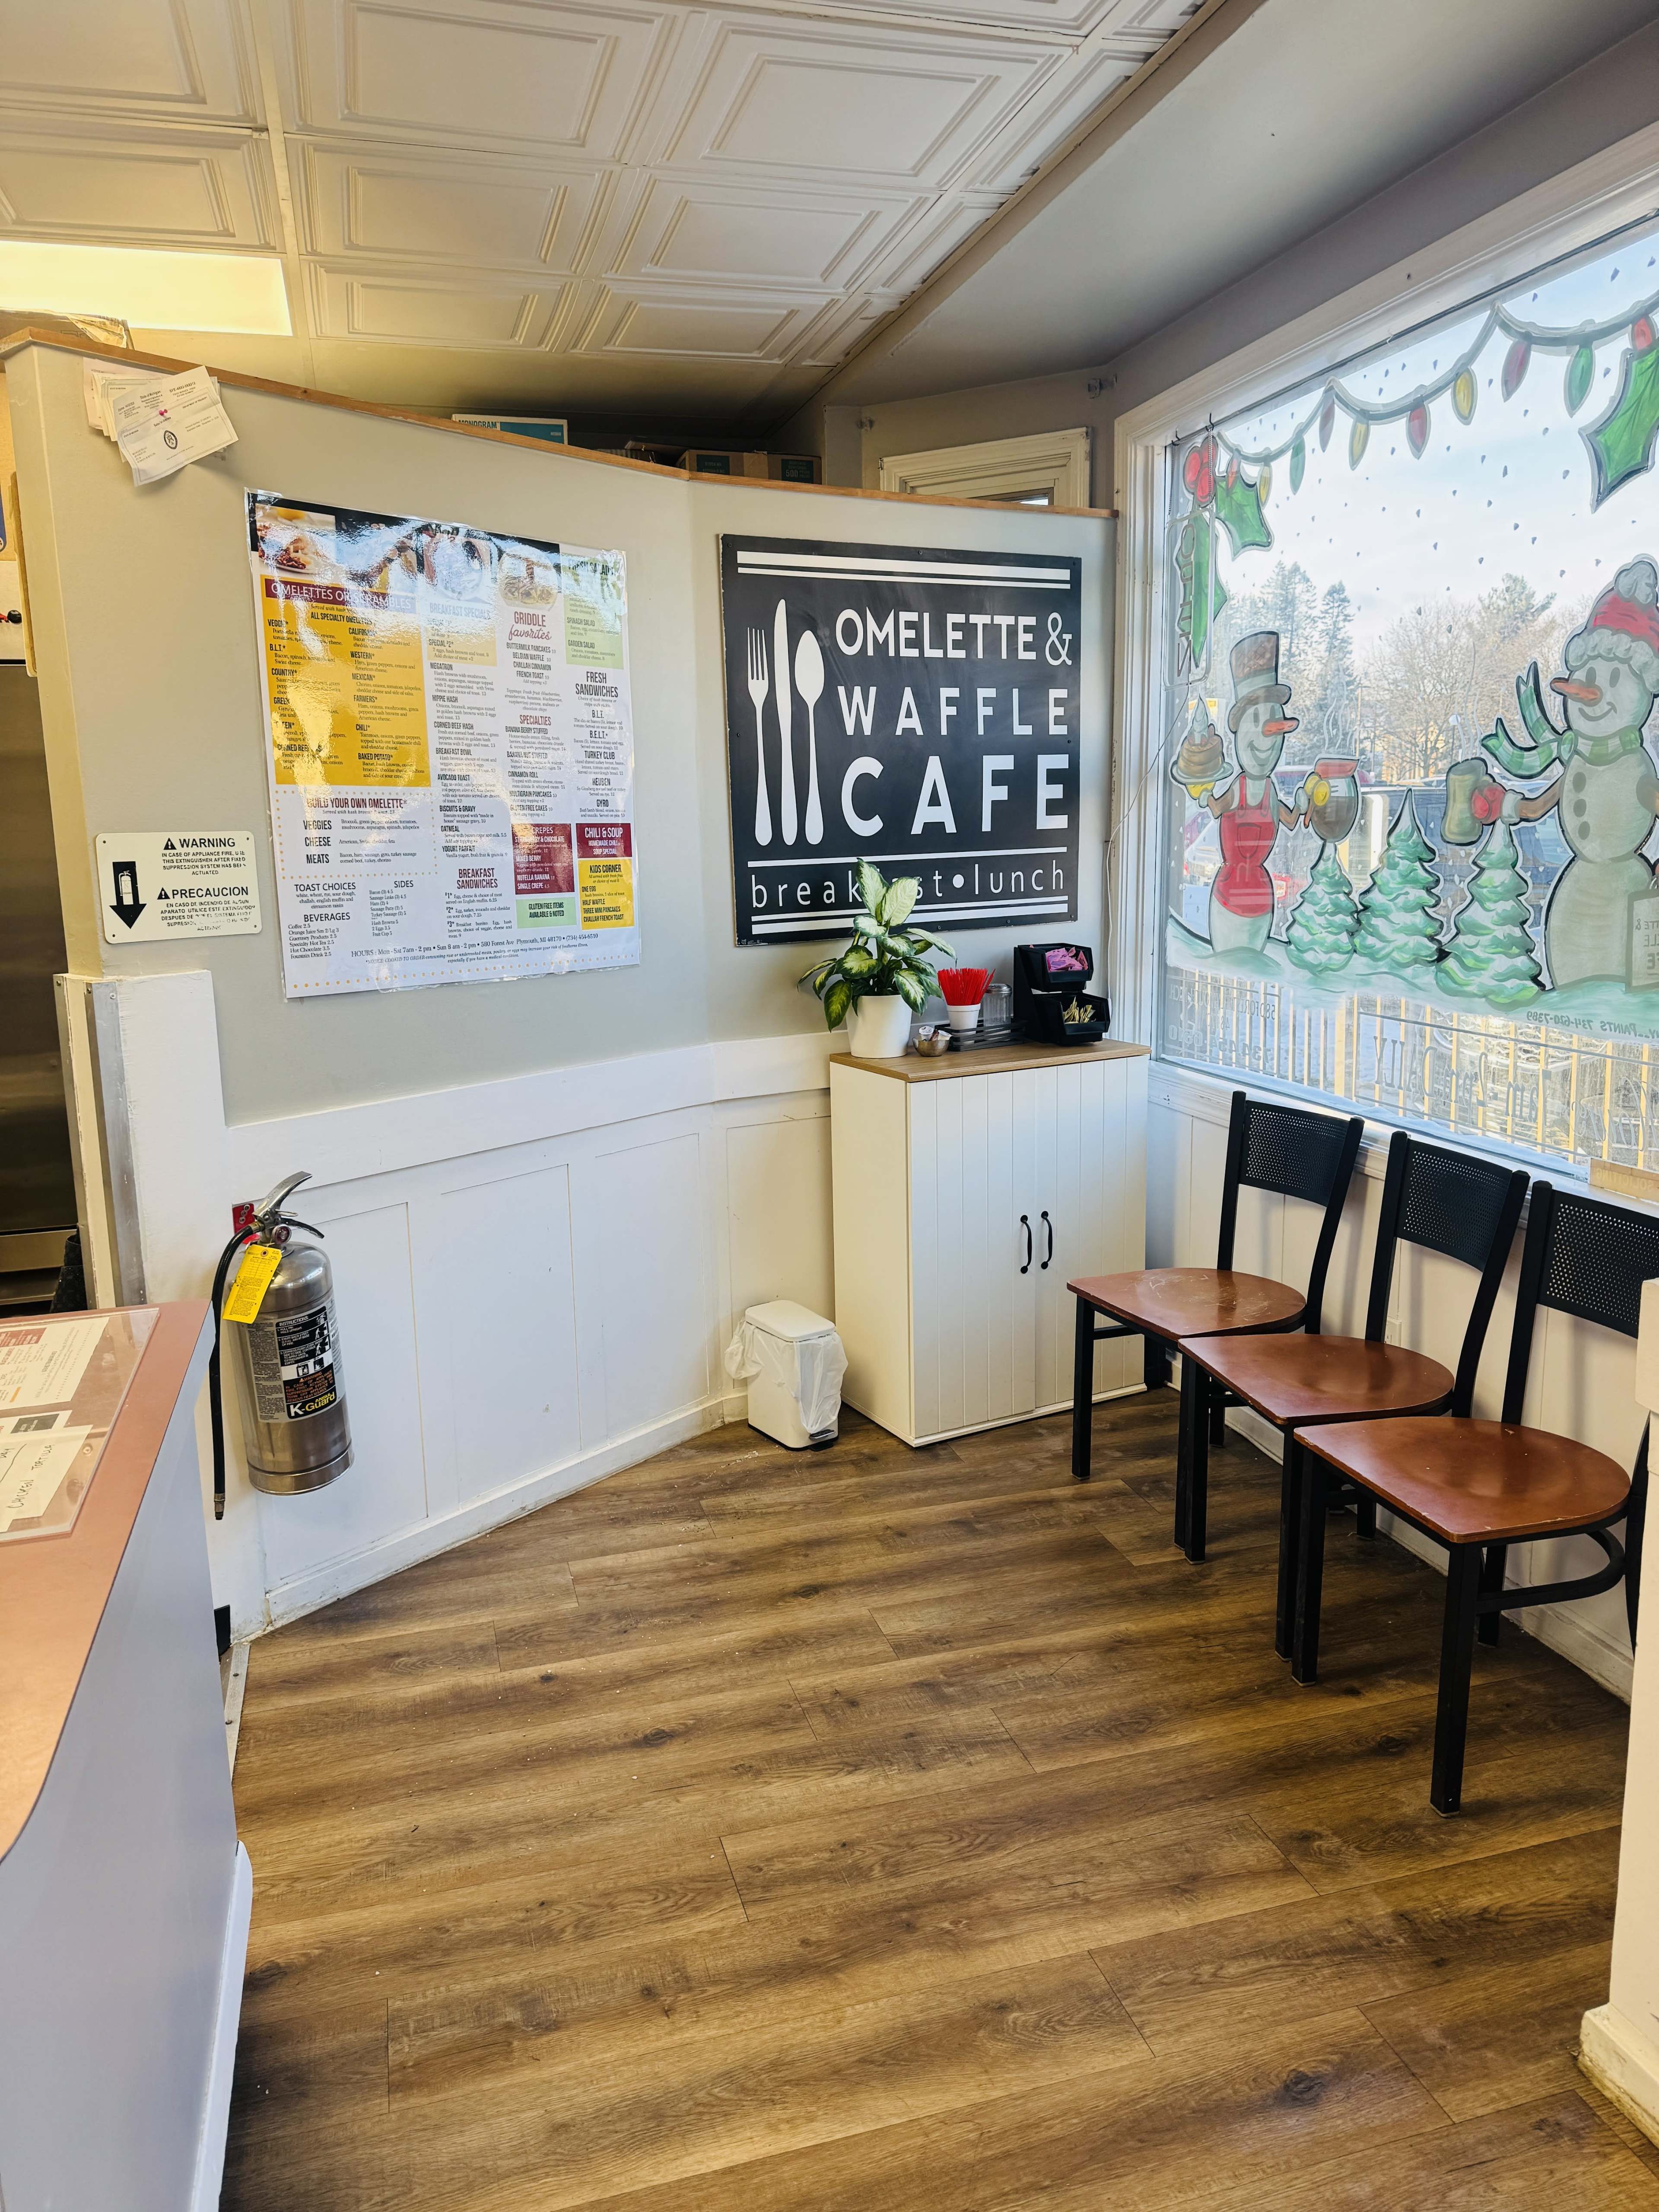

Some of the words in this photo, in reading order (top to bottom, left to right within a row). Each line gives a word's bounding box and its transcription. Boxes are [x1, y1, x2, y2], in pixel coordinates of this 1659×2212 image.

[354, 592, 411, 609] SRAMBLES
[430, 603, 463, 617] BREAKFAST
[321, 613, 345, 622] SPECIALTY
[514, 611, 546, 627] GRIDDLE
[509, 624, 552, 640] favorites
[835, 606, 1037, 660] OMELETTE
[1044, 611, 1072, 666] &
[506, 642, 531, 651] BUTTERMILK
[531, 645, 551, 653] PANCAKES
[430, 662, 453, 671] MEGATRON
[513, 661, 531, 669] CHALLAH
[586, 671, 607, 683] FRESH
[575, 683, 618, 698] SANDWICHES
[837, 686, 1068, 736] WAFFLE
[519, 715, 551, 726] SPECIALTIES
[584, 750, 602, 759] TURKEY
[604, 751, 615, 760] CLUB
[840, 753, 1069, 837] CAFE
[331, 798, 349, 808] YOUR
[351, 798, 367, 808] OWN
[303, 820, 332, 830] VEGGIES
[585, 827, 601, 838] CHILI
[602, 828, 607, 838] &
[608, 827, 623, 838] SOUP
[179, 838, 235, 848] WARNING
[305, 837, 331, 847] CHEESE
[306, 854, 329, 864] MEATS
[459, 868, 494, 878] BREAKFAST
[590, 865, 601, 873] KIDS
[602, 864, 622, 873] CORNER
[323, 882, 356, 891] CHOICES
[457, 878, 498, 889] SANDWICHES
[751, 870, 943, 908] breakt
[975, 860, 1064, 894] lunch
[172, 886, 249, 899] PRECAUCION
[304, 912, 350, 922] BEVERAGES
[290, 1392, 335, 1417] K-Guard
